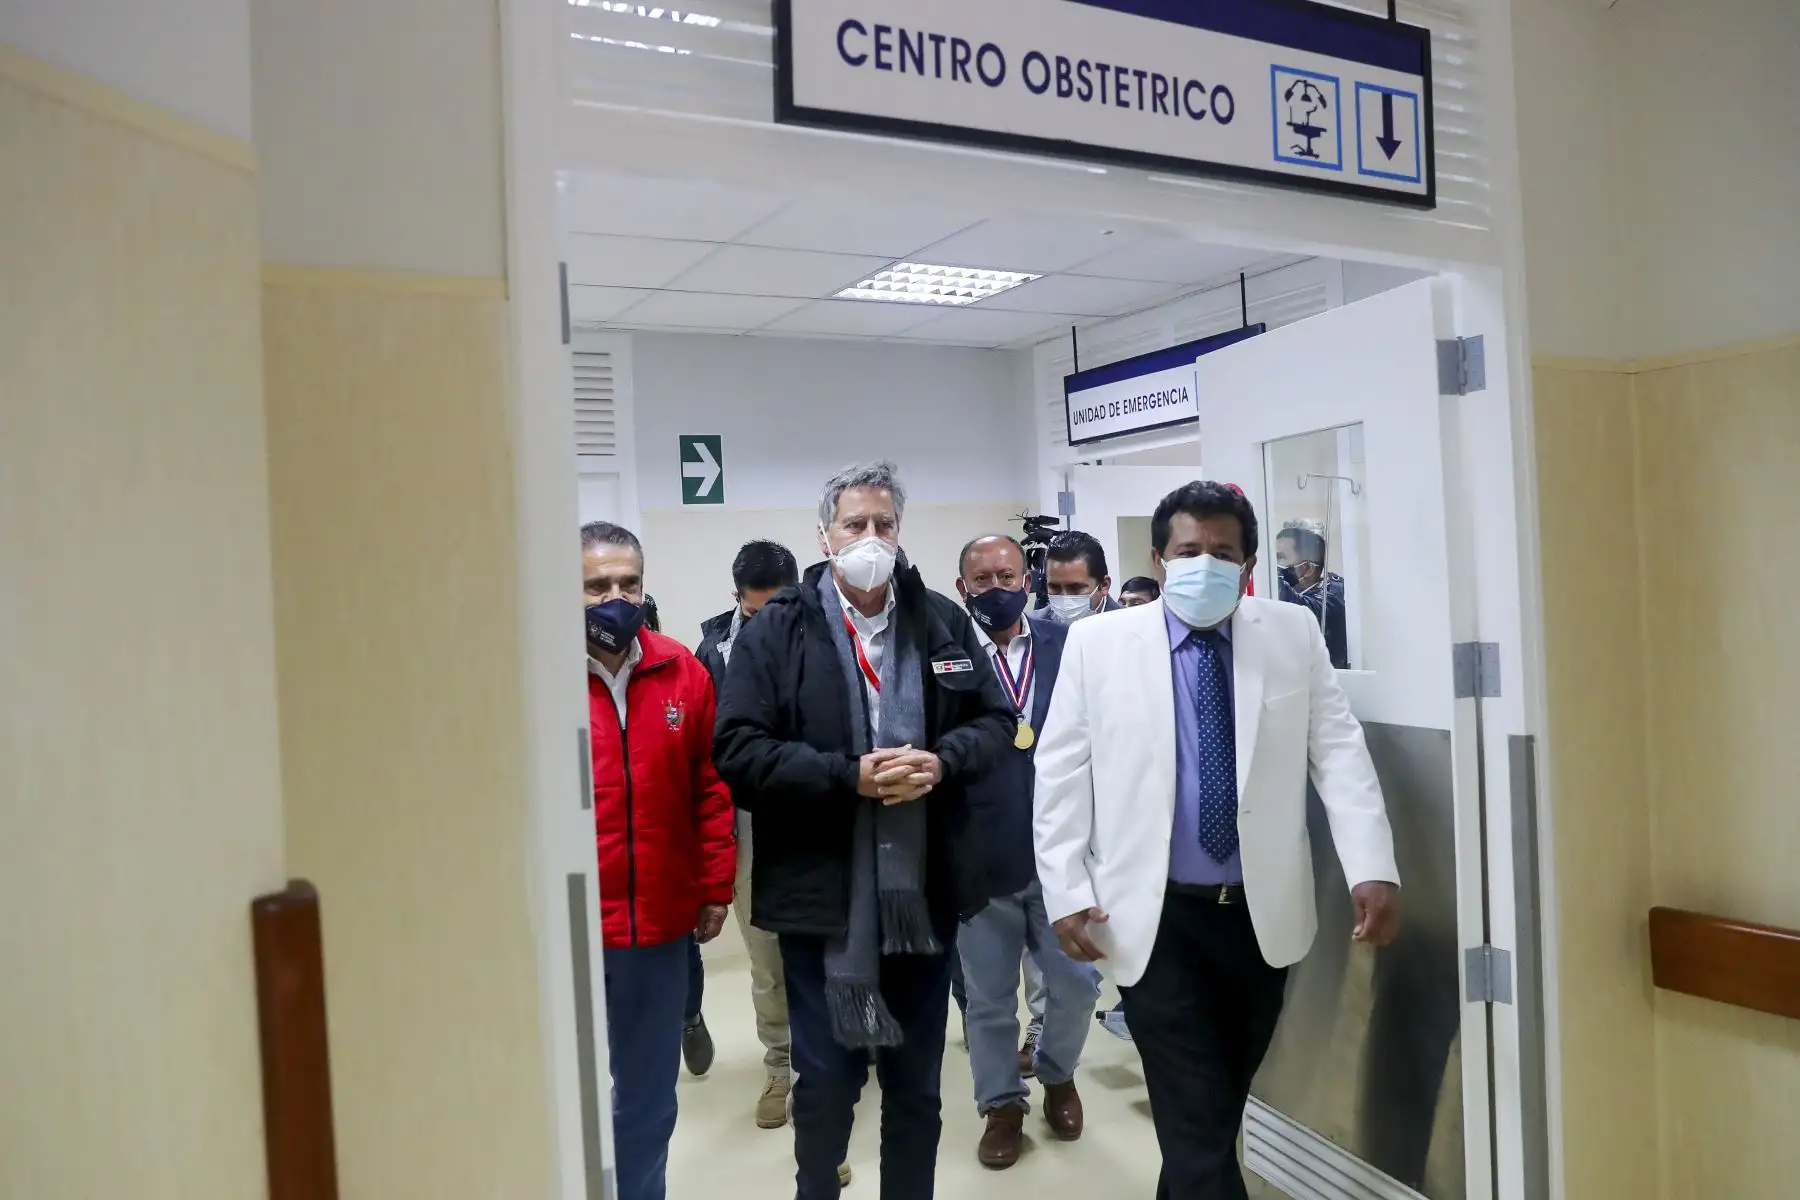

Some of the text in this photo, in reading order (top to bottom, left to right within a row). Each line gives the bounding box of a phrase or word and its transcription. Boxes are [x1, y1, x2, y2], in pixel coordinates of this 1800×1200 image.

[836, 19, 1235, 125] CENTRO OBSTETRICO
[1073, 386, 1189, 425] UNIDAD DE EMERGENCIA
